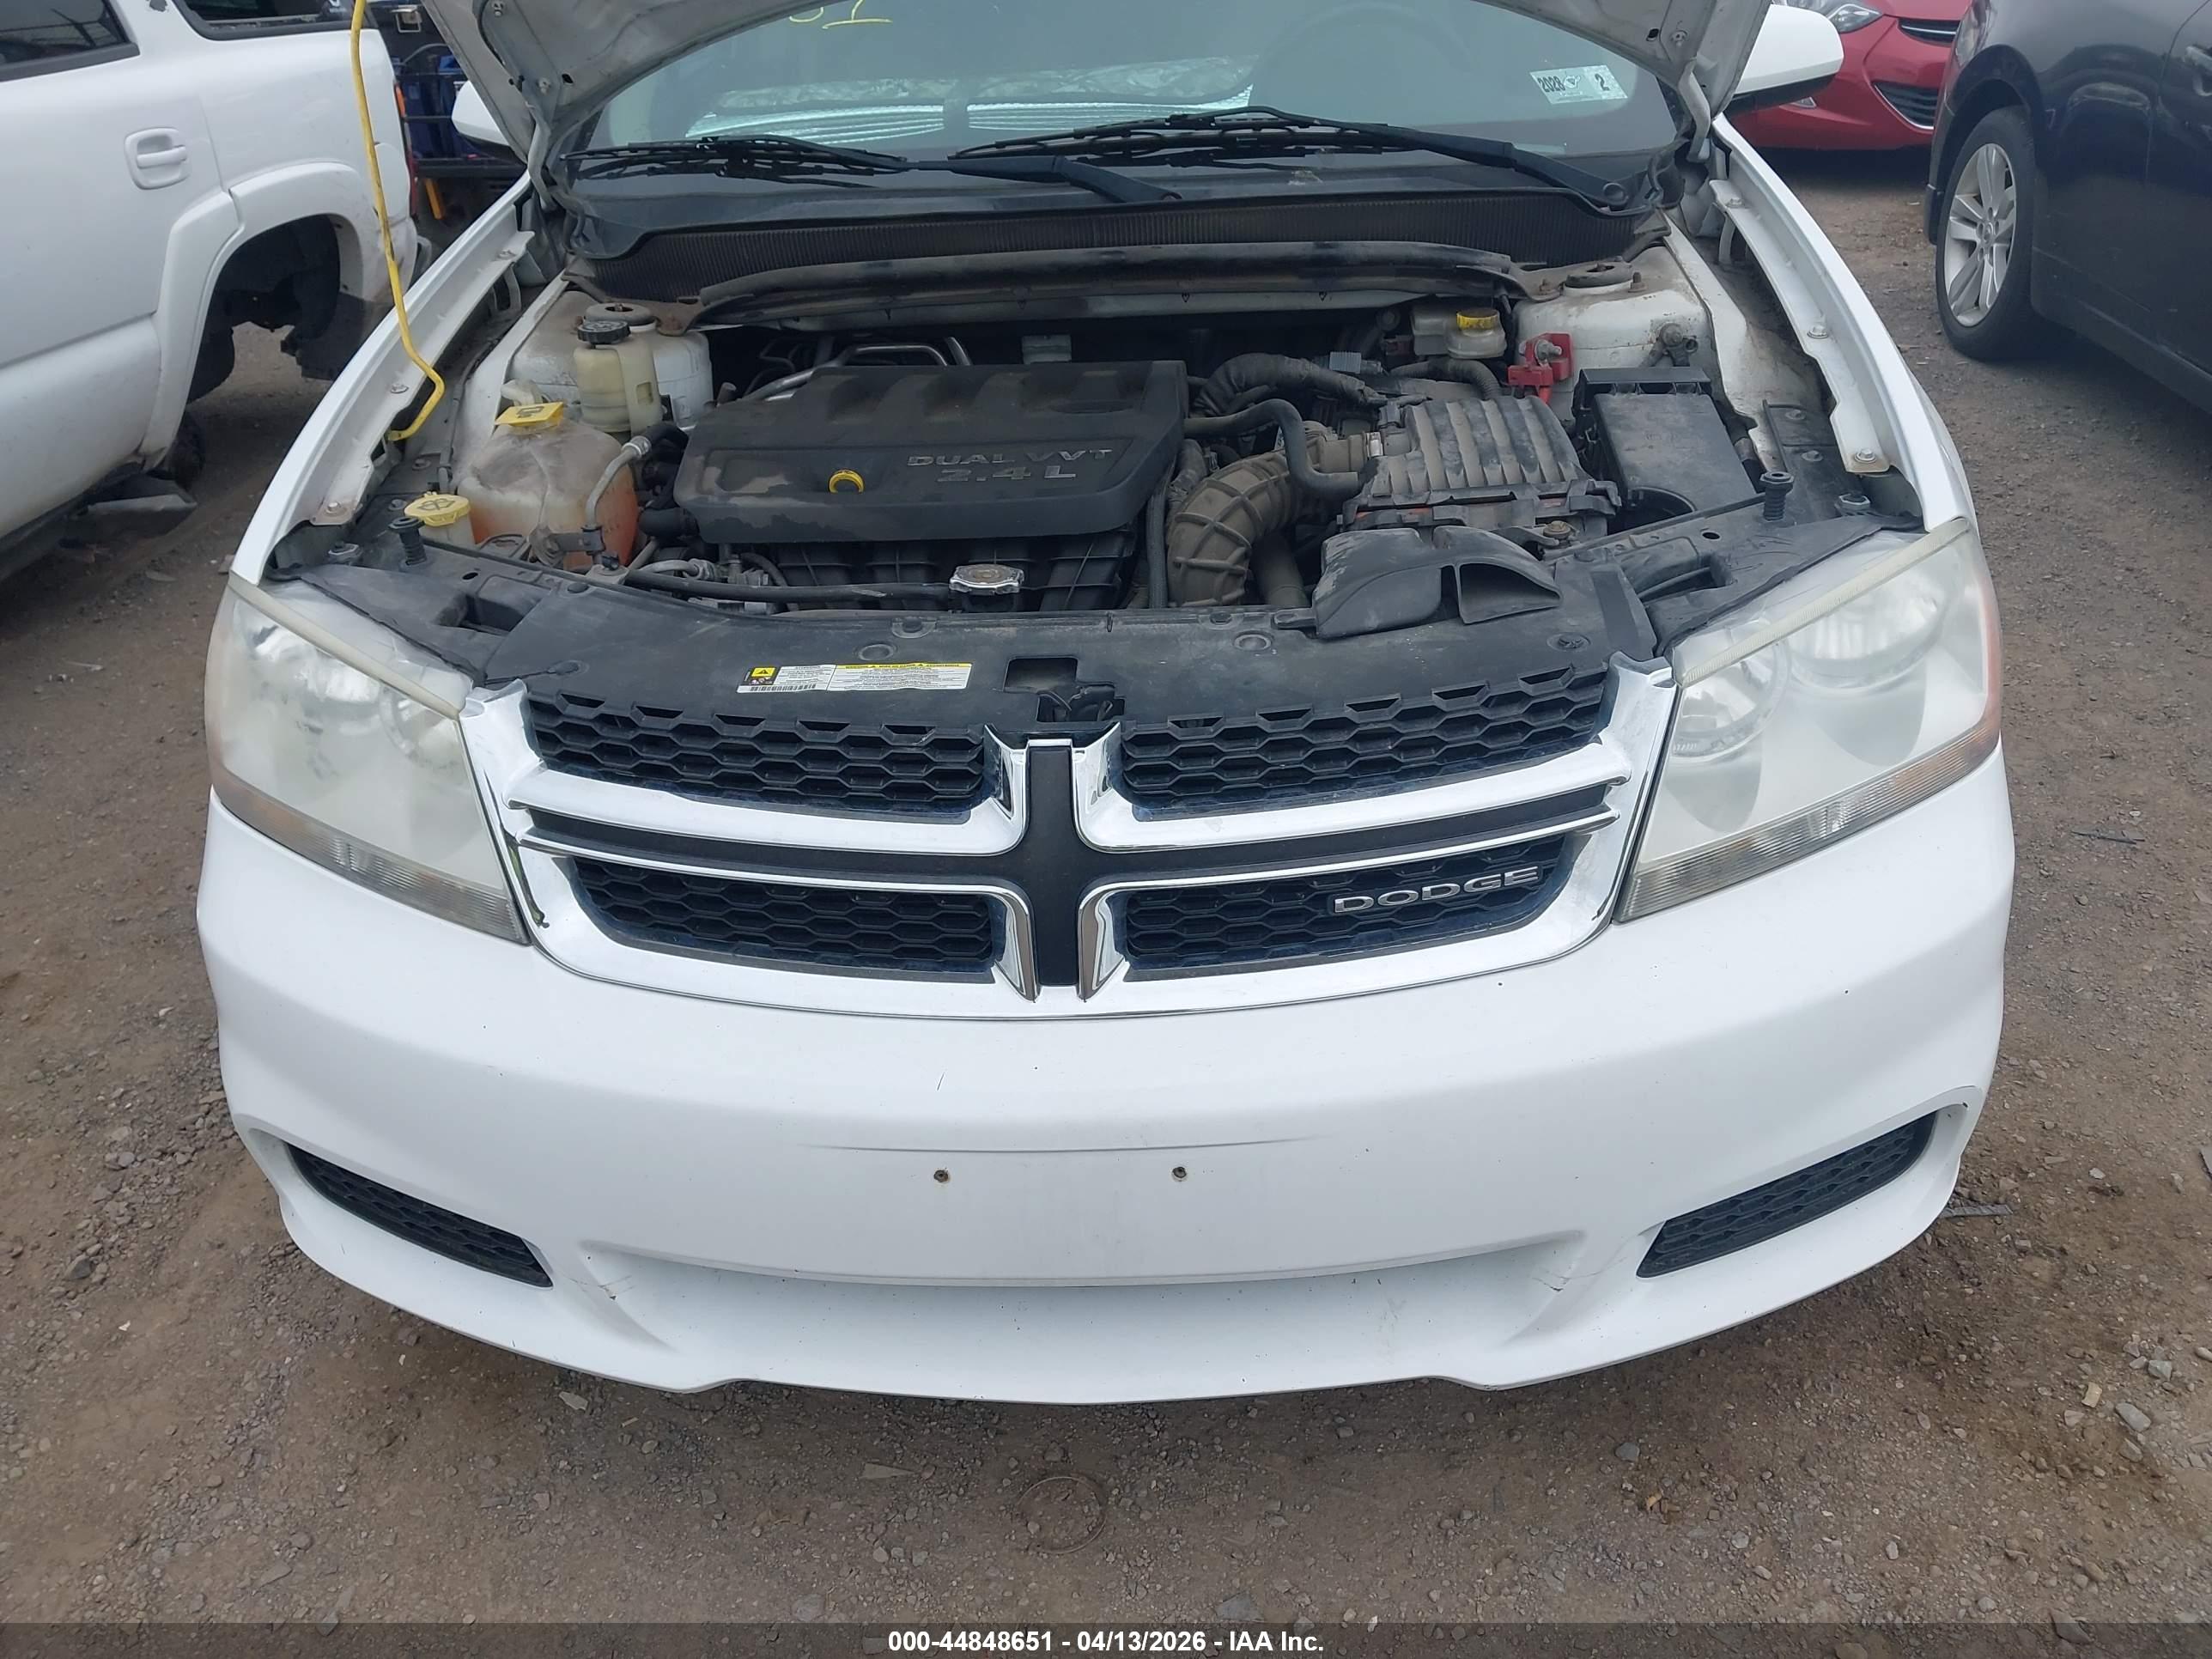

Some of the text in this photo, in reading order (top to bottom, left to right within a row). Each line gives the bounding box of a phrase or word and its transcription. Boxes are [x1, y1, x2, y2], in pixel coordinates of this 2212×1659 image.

[1537, 73, 1610, 93] 2028 2
[907, 448, 1114, 466] DUAL VVT
[1334, 866, 1539, 914] DODGE
